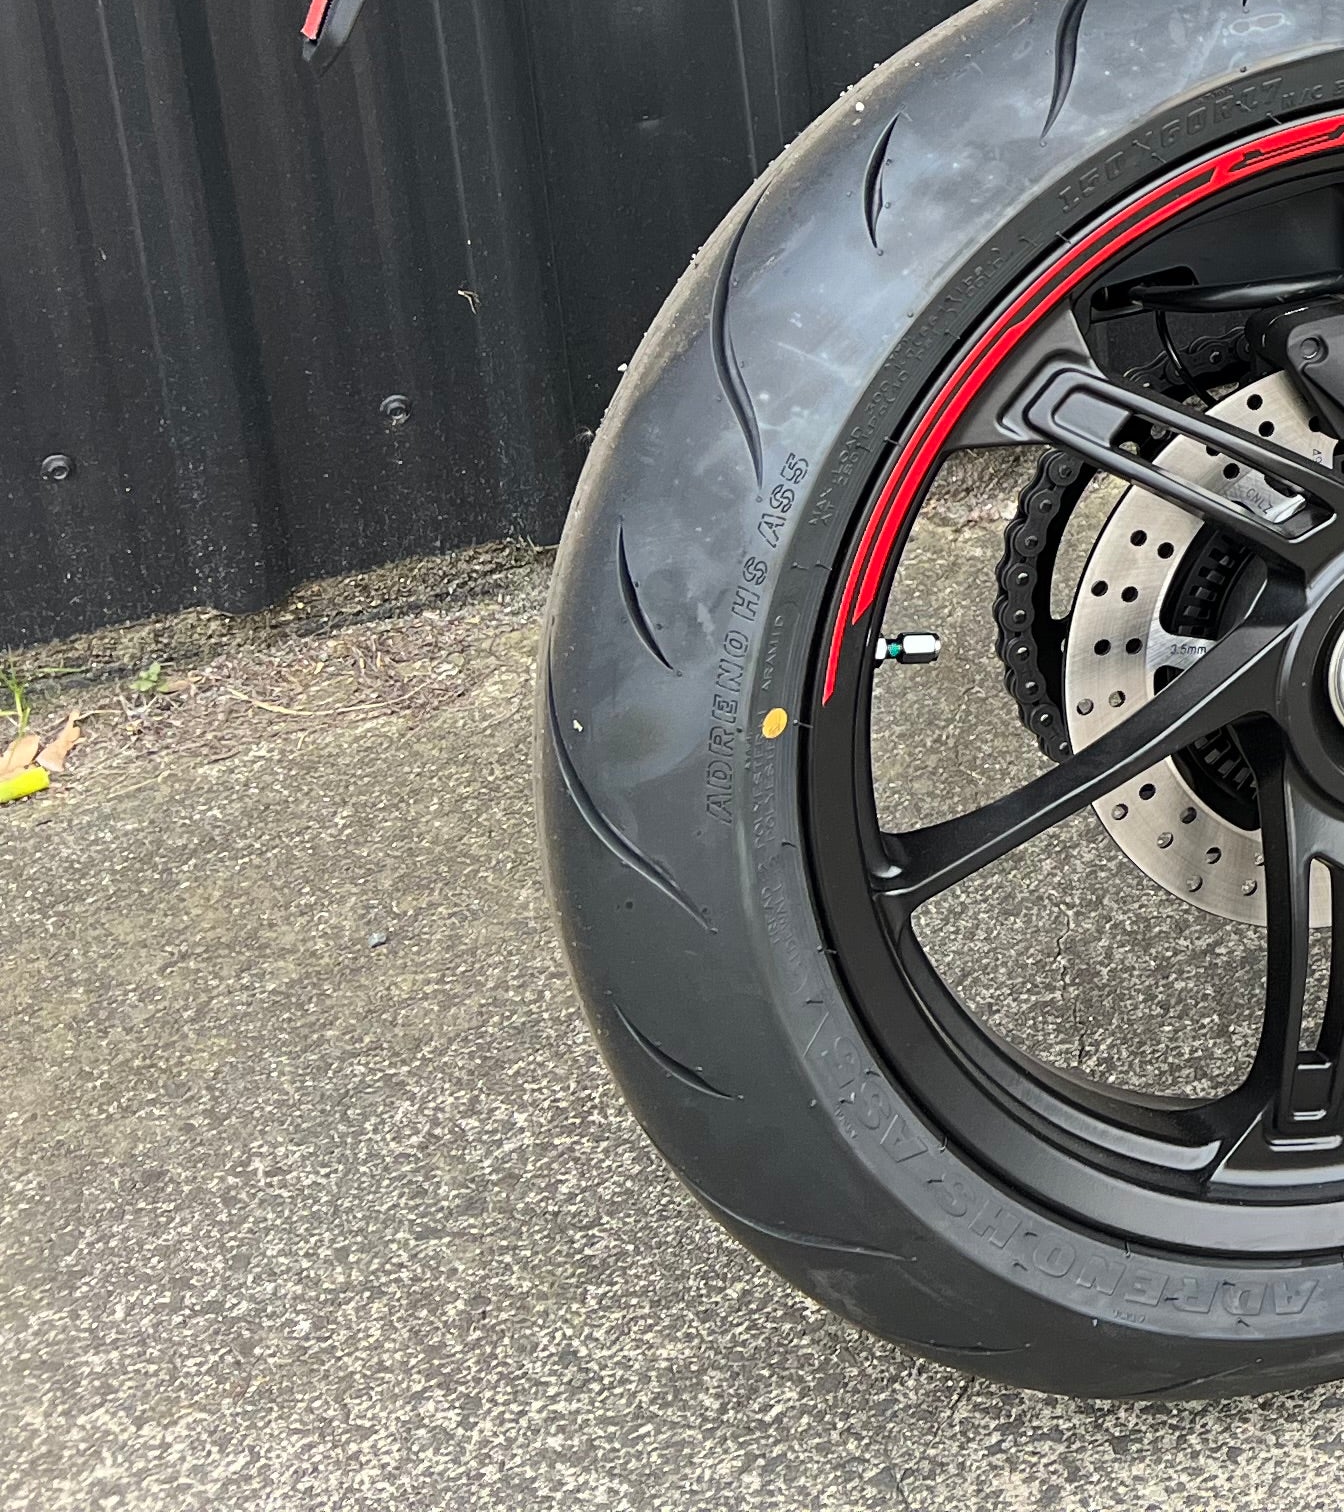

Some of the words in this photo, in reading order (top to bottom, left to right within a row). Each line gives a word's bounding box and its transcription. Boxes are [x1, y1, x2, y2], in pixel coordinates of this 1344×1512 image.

[750, 449, 813, 550] AS5
[725, 554, 773, 622] HS
[759, 612, 786, 691] ARAMID
[705, 628, 752, 829] ADRENO
[1025, 1230, 1320, 1317] ADRENO
